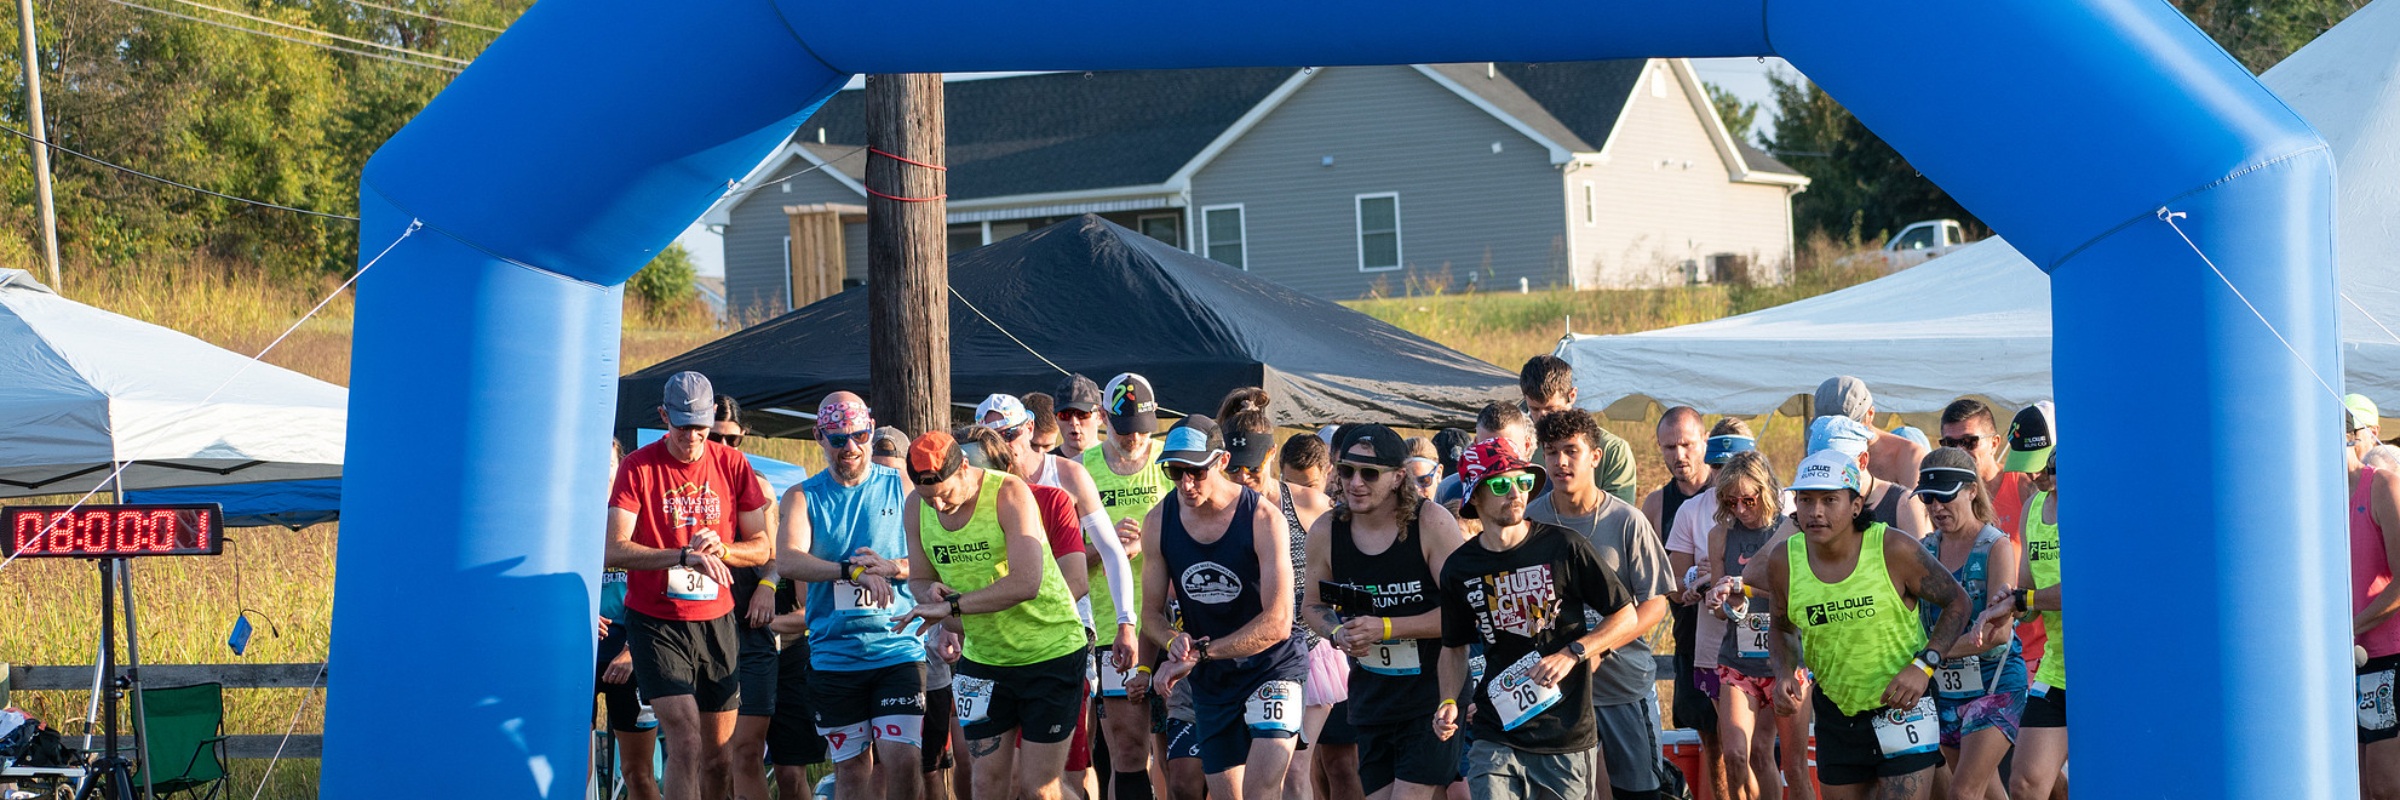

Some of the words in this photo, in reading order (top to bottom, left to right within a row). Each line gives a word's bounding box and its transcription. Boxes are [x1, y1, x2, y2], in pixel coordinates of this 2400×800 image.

[1117, 486, 1157, 497] 2LOWE
[662, 504, 720, 514] CHALLENGE
[1118, 498, 1139, 507] RUN
[1143, 496, 1158, 504] CO
[17, 510, 208, 553] 08:00:01
[948, 541, 989, 554] 2LOWE
[952, 554, 973, 563] RUN
[975, 551, 991, 561] CO
[687, 574, 704, 592] 34
[1366, 580, 1422, 595] 2LOWE
[1494, 570, 1542, 596] HUB
[854, 588, 873, 607] 20
[1402, 594, 1423, 604] CO
[1463, 576, 1485, 610] 13.1
[1497, 589, 1546, 614] CITY
[1827, 596, 1874, 611] 2LOWE
[1829, 612, 1853, 623] RUN
[1856, 607, 1876, 618] CO
[1380, 646, 1391, 666] 9
[1943, 671, 1962, 690] 33
[1513, 684, 1538, 712] 26
[1263, 701, 1283, 720] 56
[1905, 724, 1919, 744] 6
